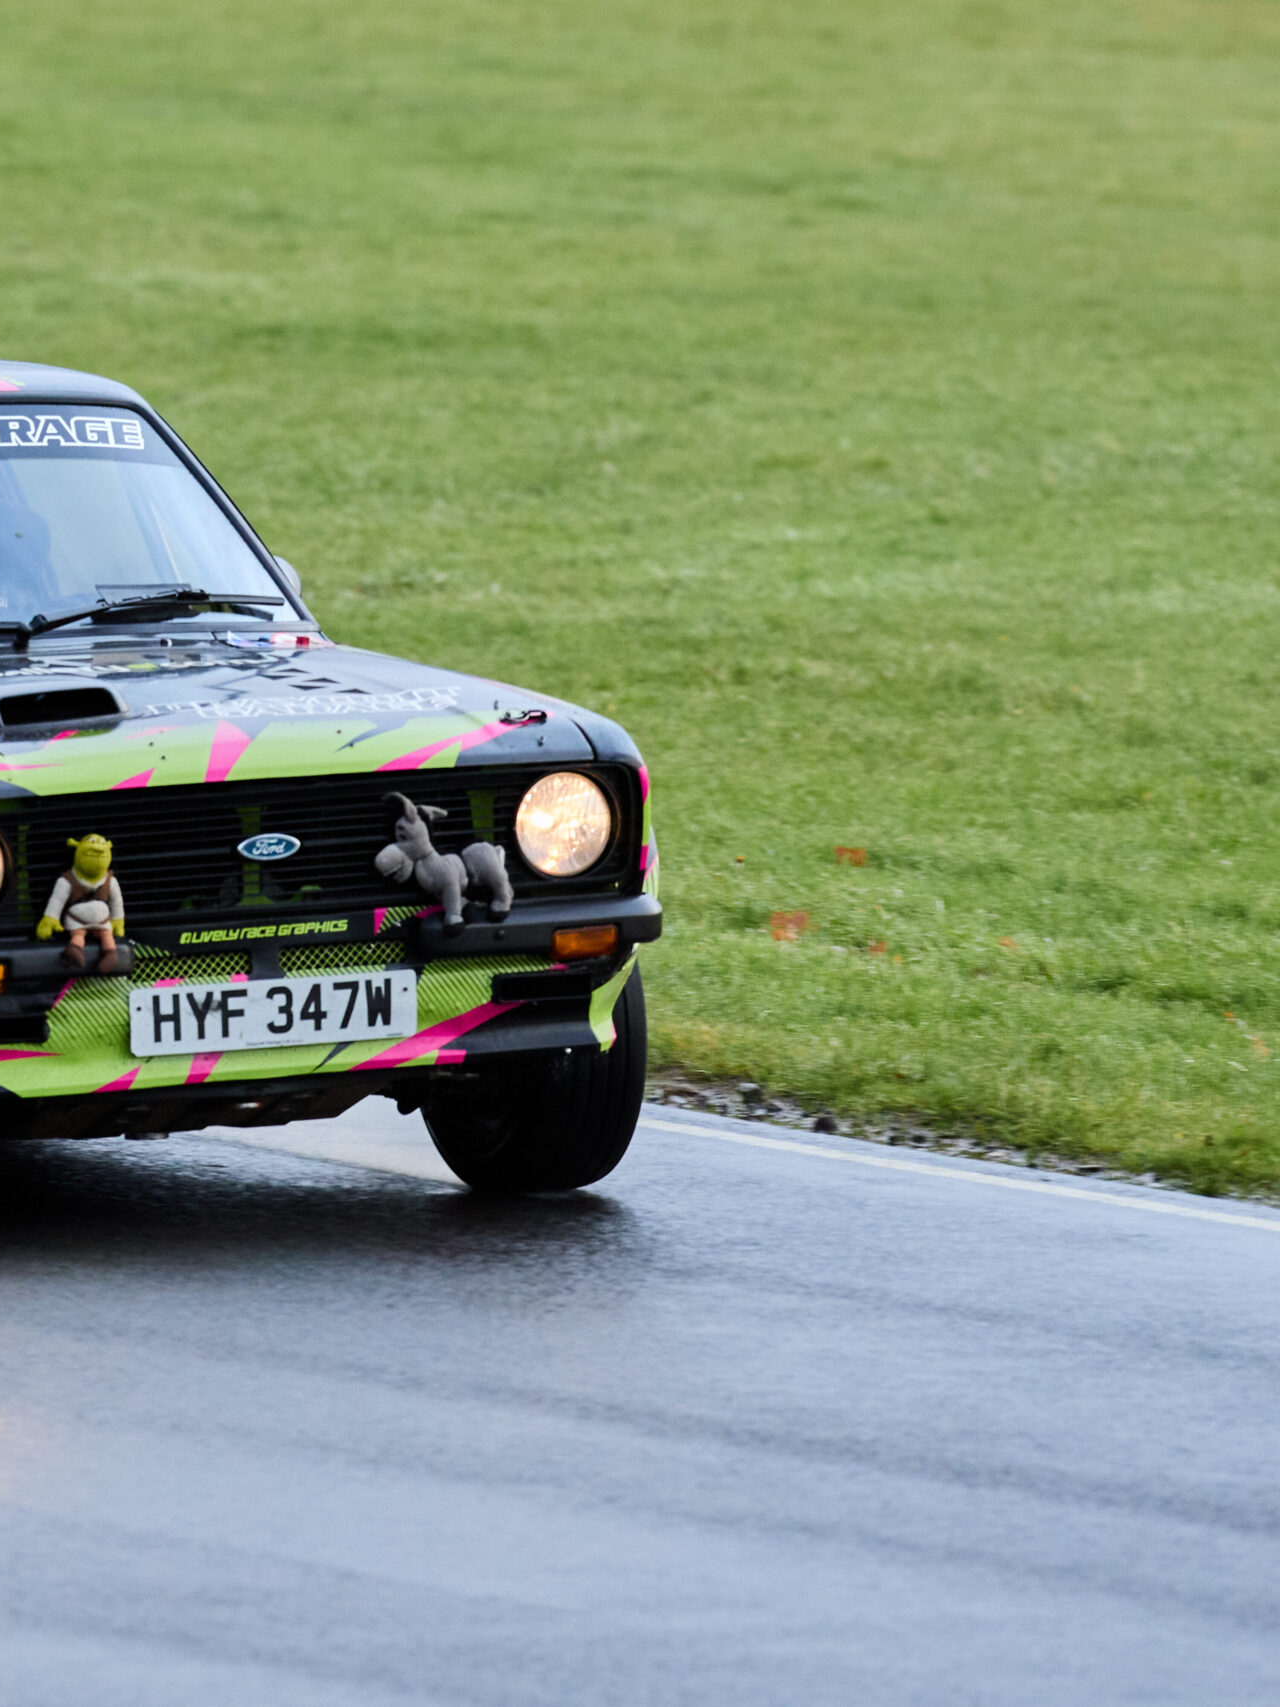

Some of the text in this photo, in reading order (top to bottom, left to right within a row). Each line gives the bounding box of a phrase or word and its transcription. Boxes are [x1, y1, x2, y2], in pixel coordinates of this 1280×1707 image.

[251, 838, 286, 855] Ford
[151, 978, 392, 1043] HYF 347W
